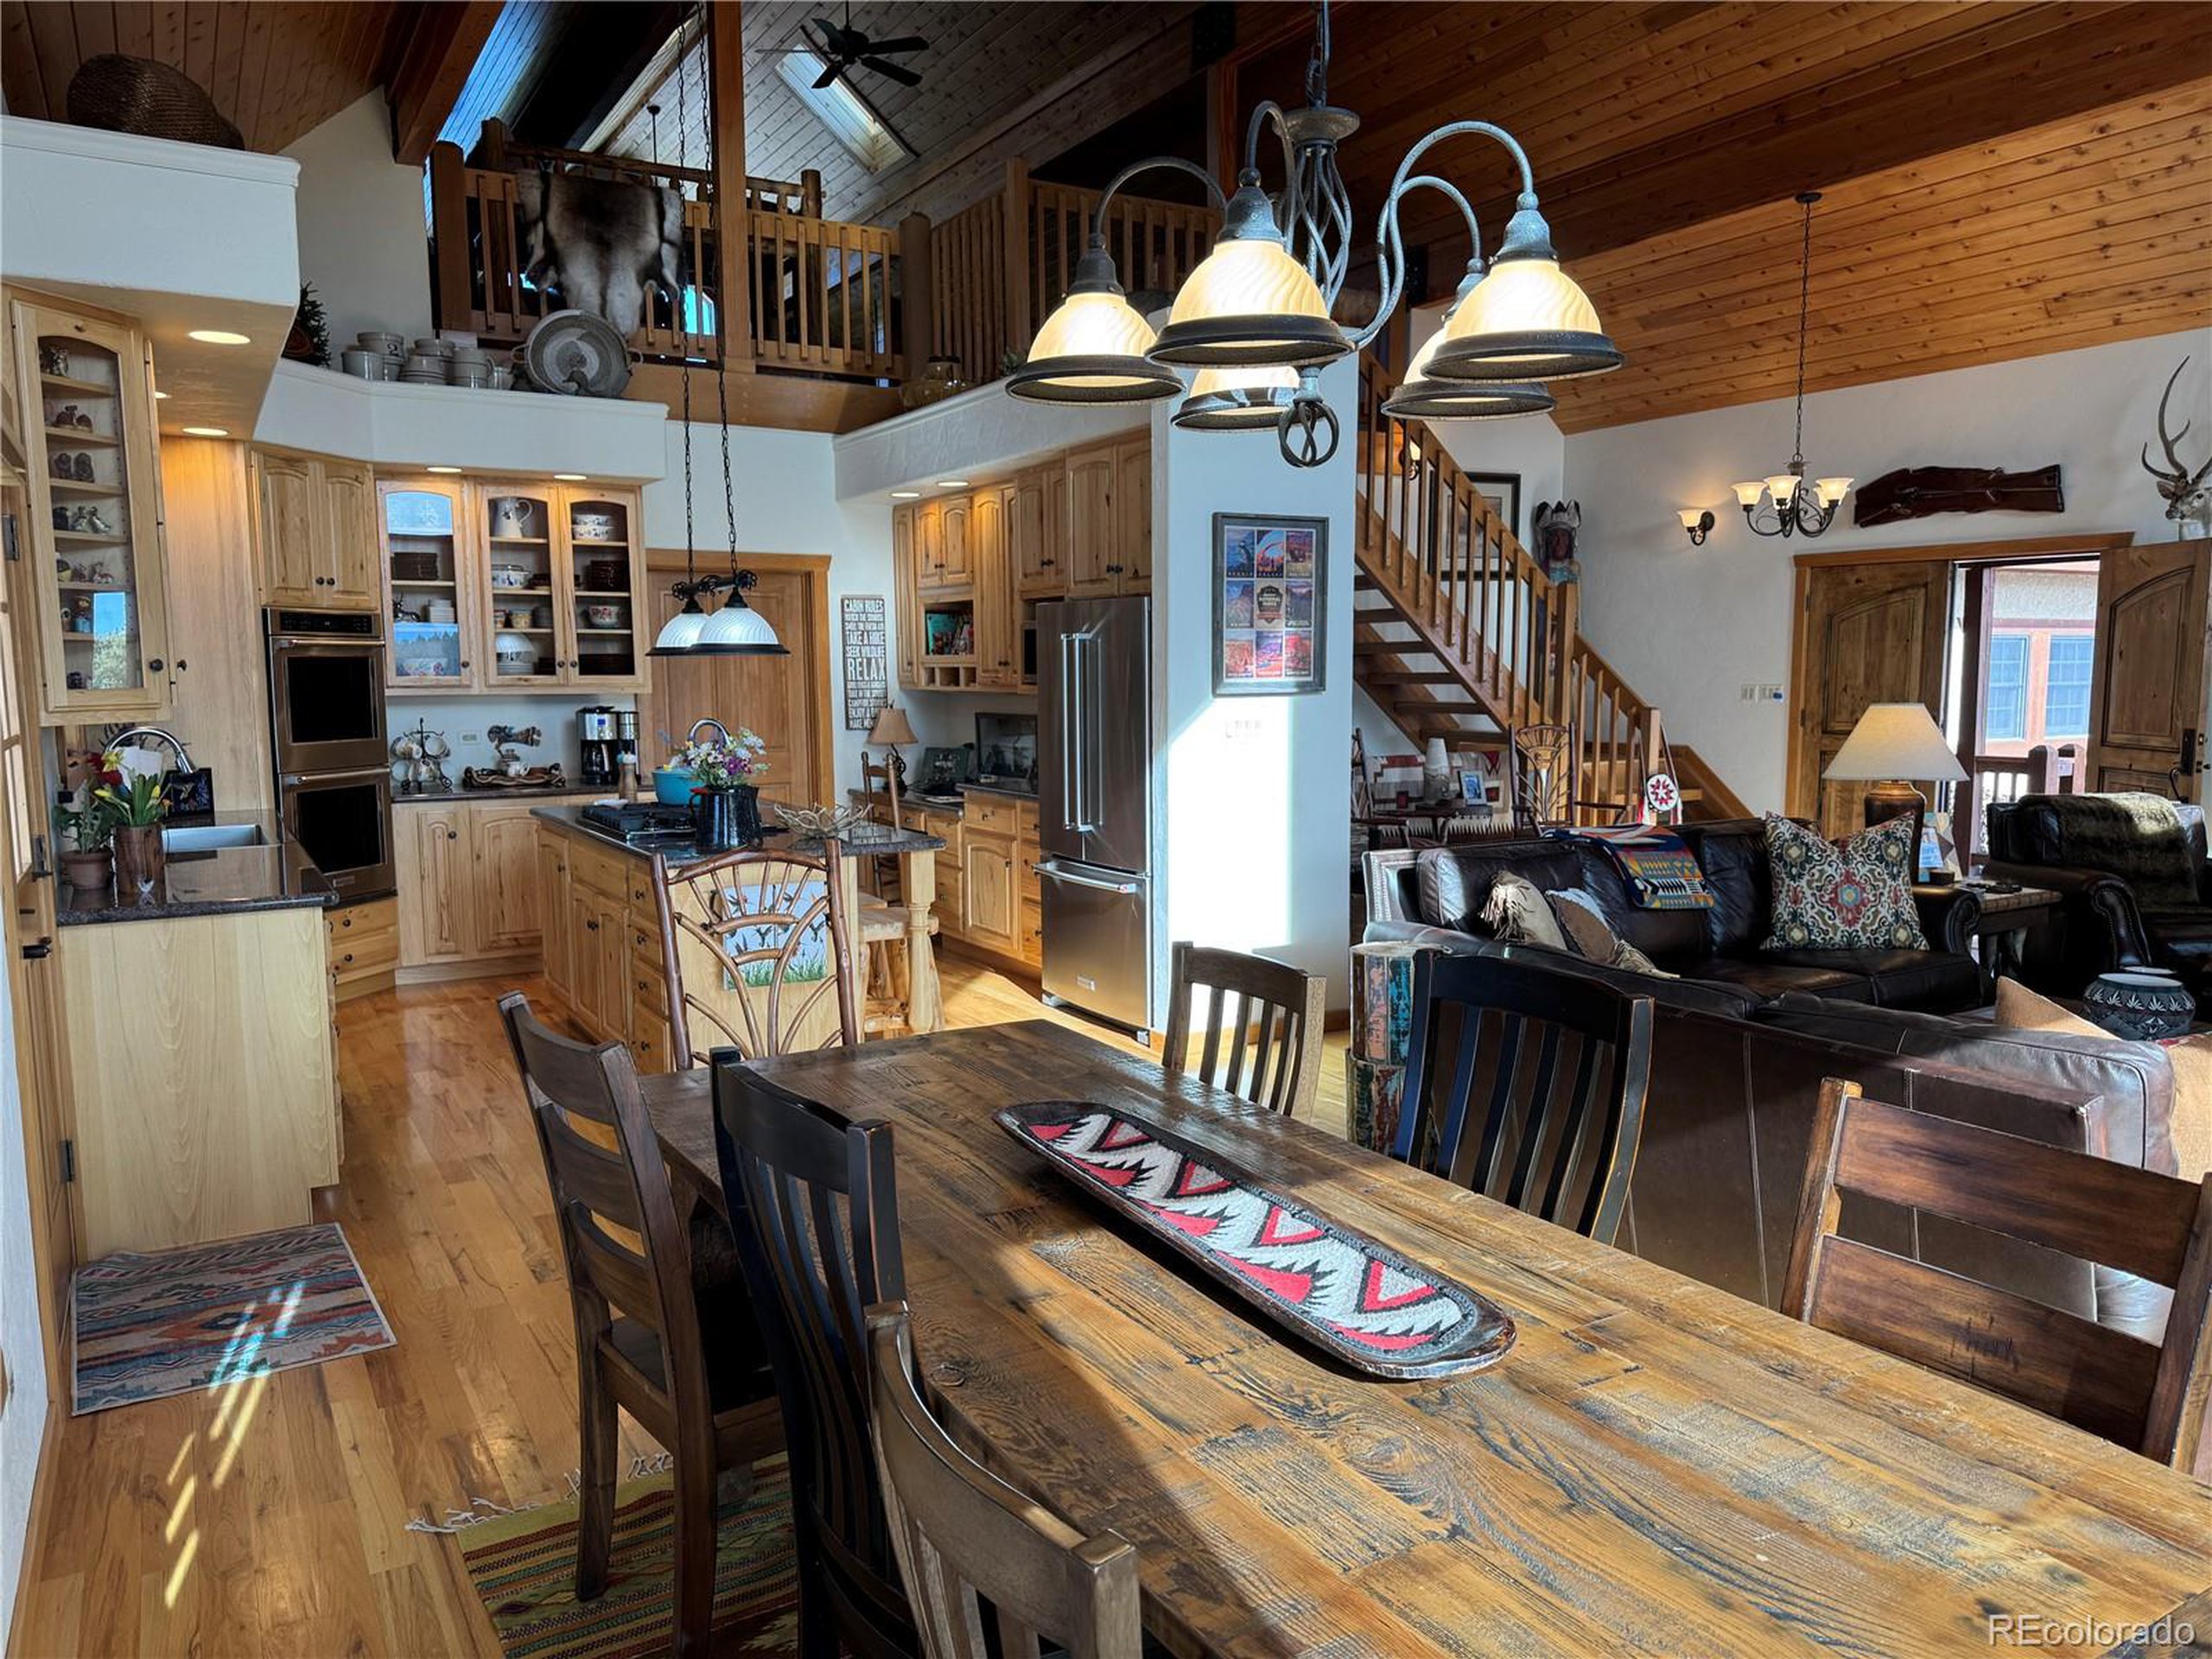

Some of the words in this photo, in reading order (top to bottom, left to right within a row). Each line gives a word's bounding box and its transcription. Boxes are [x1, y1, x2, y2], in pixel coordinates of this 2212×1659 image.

[387, 343, 398, 357] 2
[846, 631, 863, 645] TAKE
[863, 632, 868, 645] A
[869, 632, 885, 645] HIKE
[845, 645, 861, 657] SEEK
[847, 658, 886, 680] RELAX
